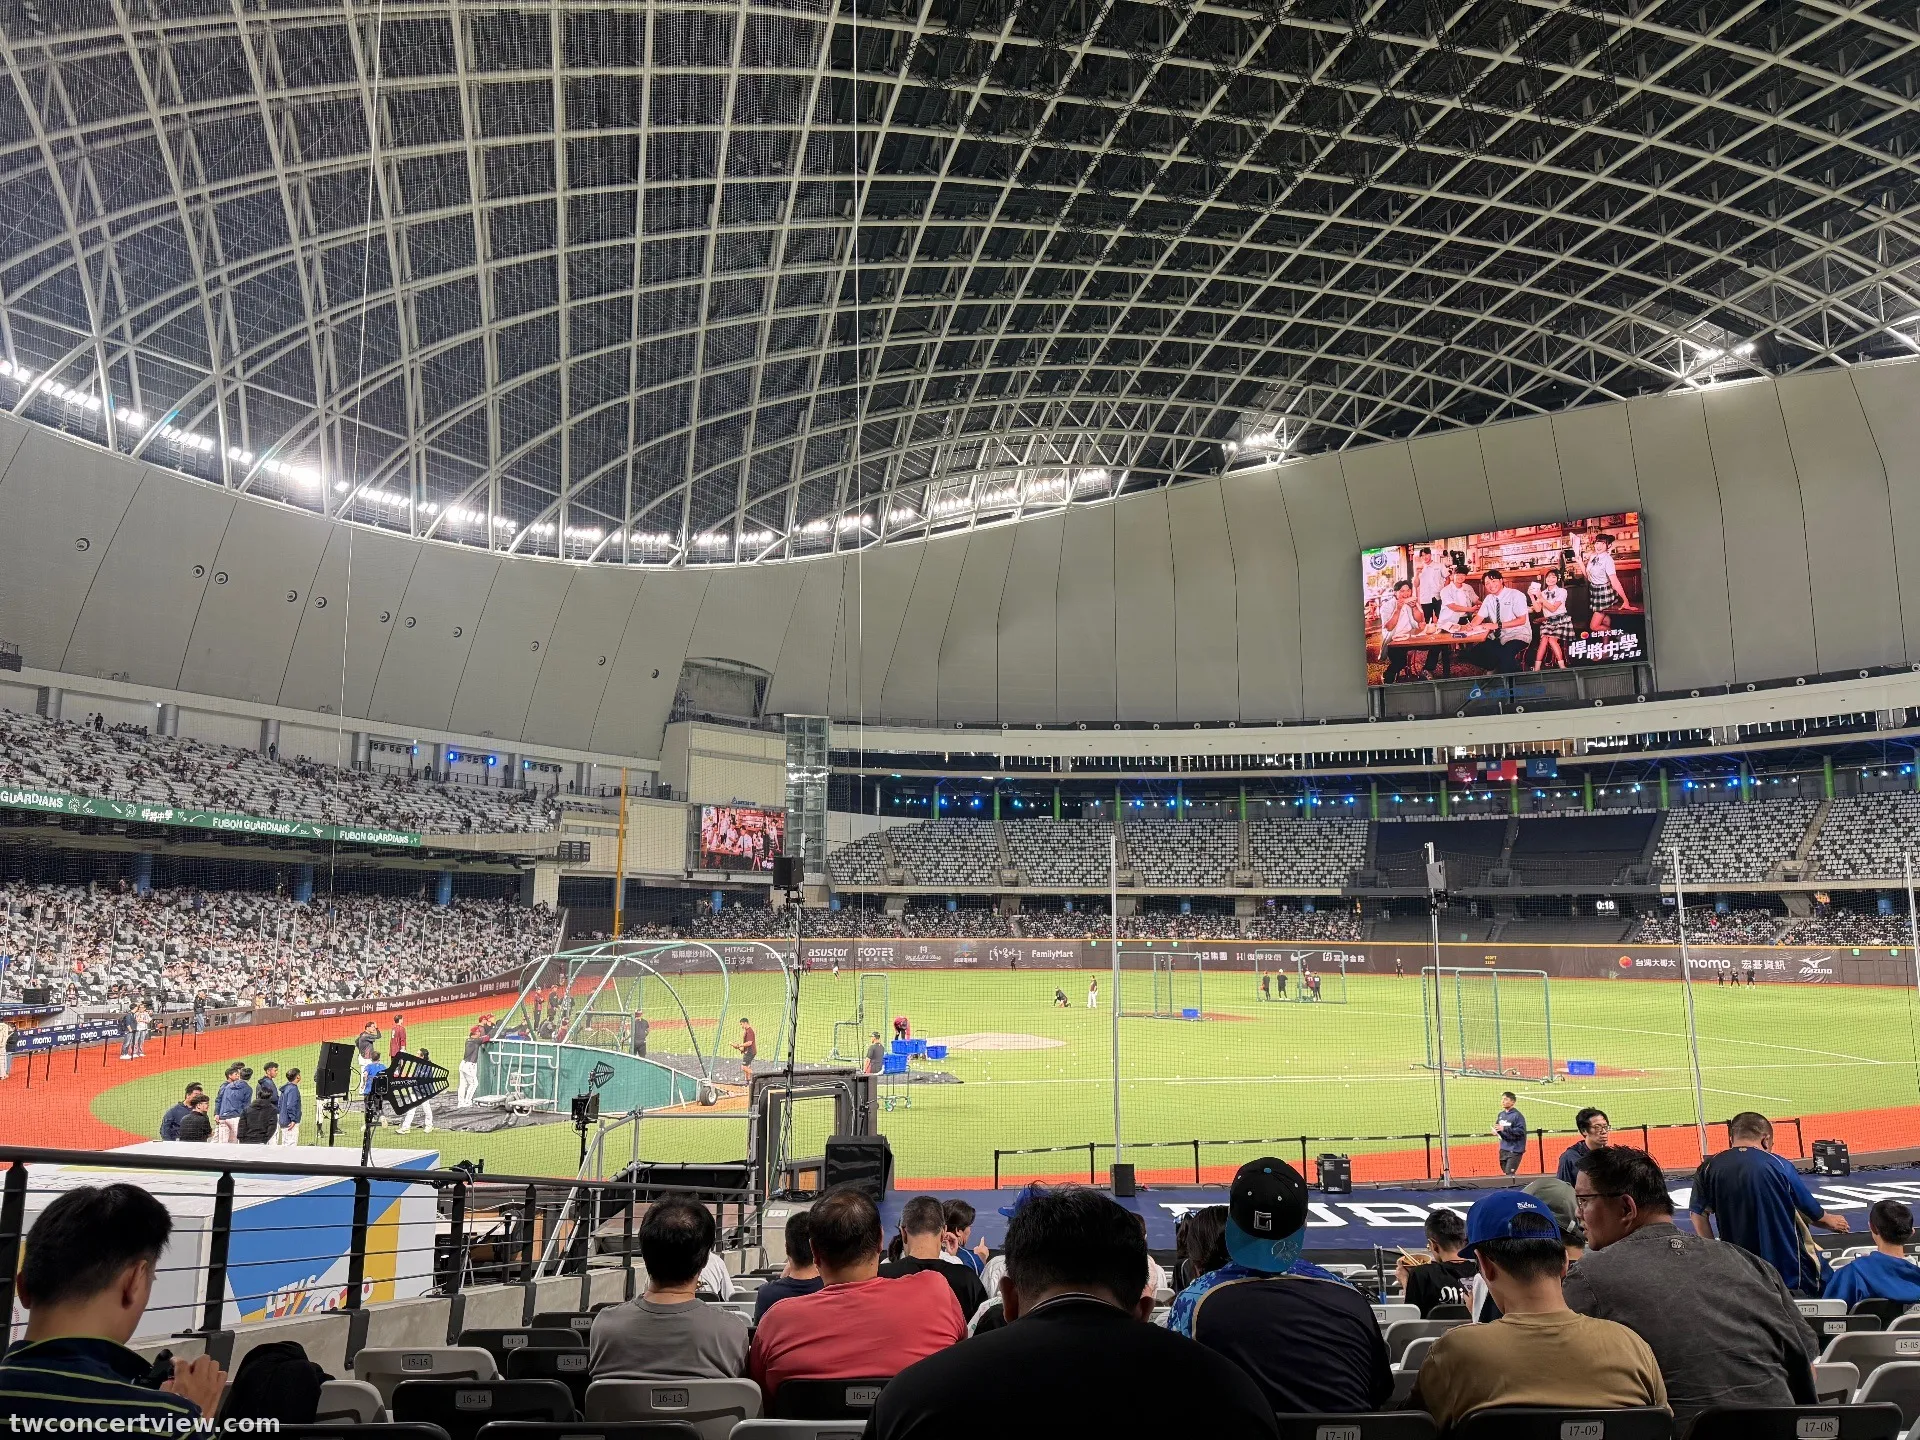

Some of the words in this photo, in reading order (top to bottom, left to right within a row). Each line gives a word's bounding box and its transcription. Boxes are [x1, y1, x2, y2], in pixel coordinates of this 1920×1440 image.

[1, 790, 64, 808] GUARDIANS
[212, 817, 243, 830] FUBON
[243, 820, 291, 834] GUARDIANS
[340, 830, 366, 841] FUBON
[367, 832, 409, 844] GUARDIANS
[1596, 900, 1615, 910] 0:18
[808, 947, 849, 957] asustor
[857, 947, 894, 957] FOOTER
[1031, 949, 1074, 960] FamilyMart
[1687, 958, 1731, 969] momo
[407, 1358, 428, 1367] 15-15
[562, 1358, 582, 1367] 15-14
[462, 1394, 487, 1404] 16-14
[658, 1393, 684, 1404] 16-13
[852, 1391, 876, 1401] 16-12
[1568, 1425, 1598, 1437] 17-09
[1804, 1421, 1834, 1433] 17-08
[1324, 1431, 1354, 1440] 17-10
